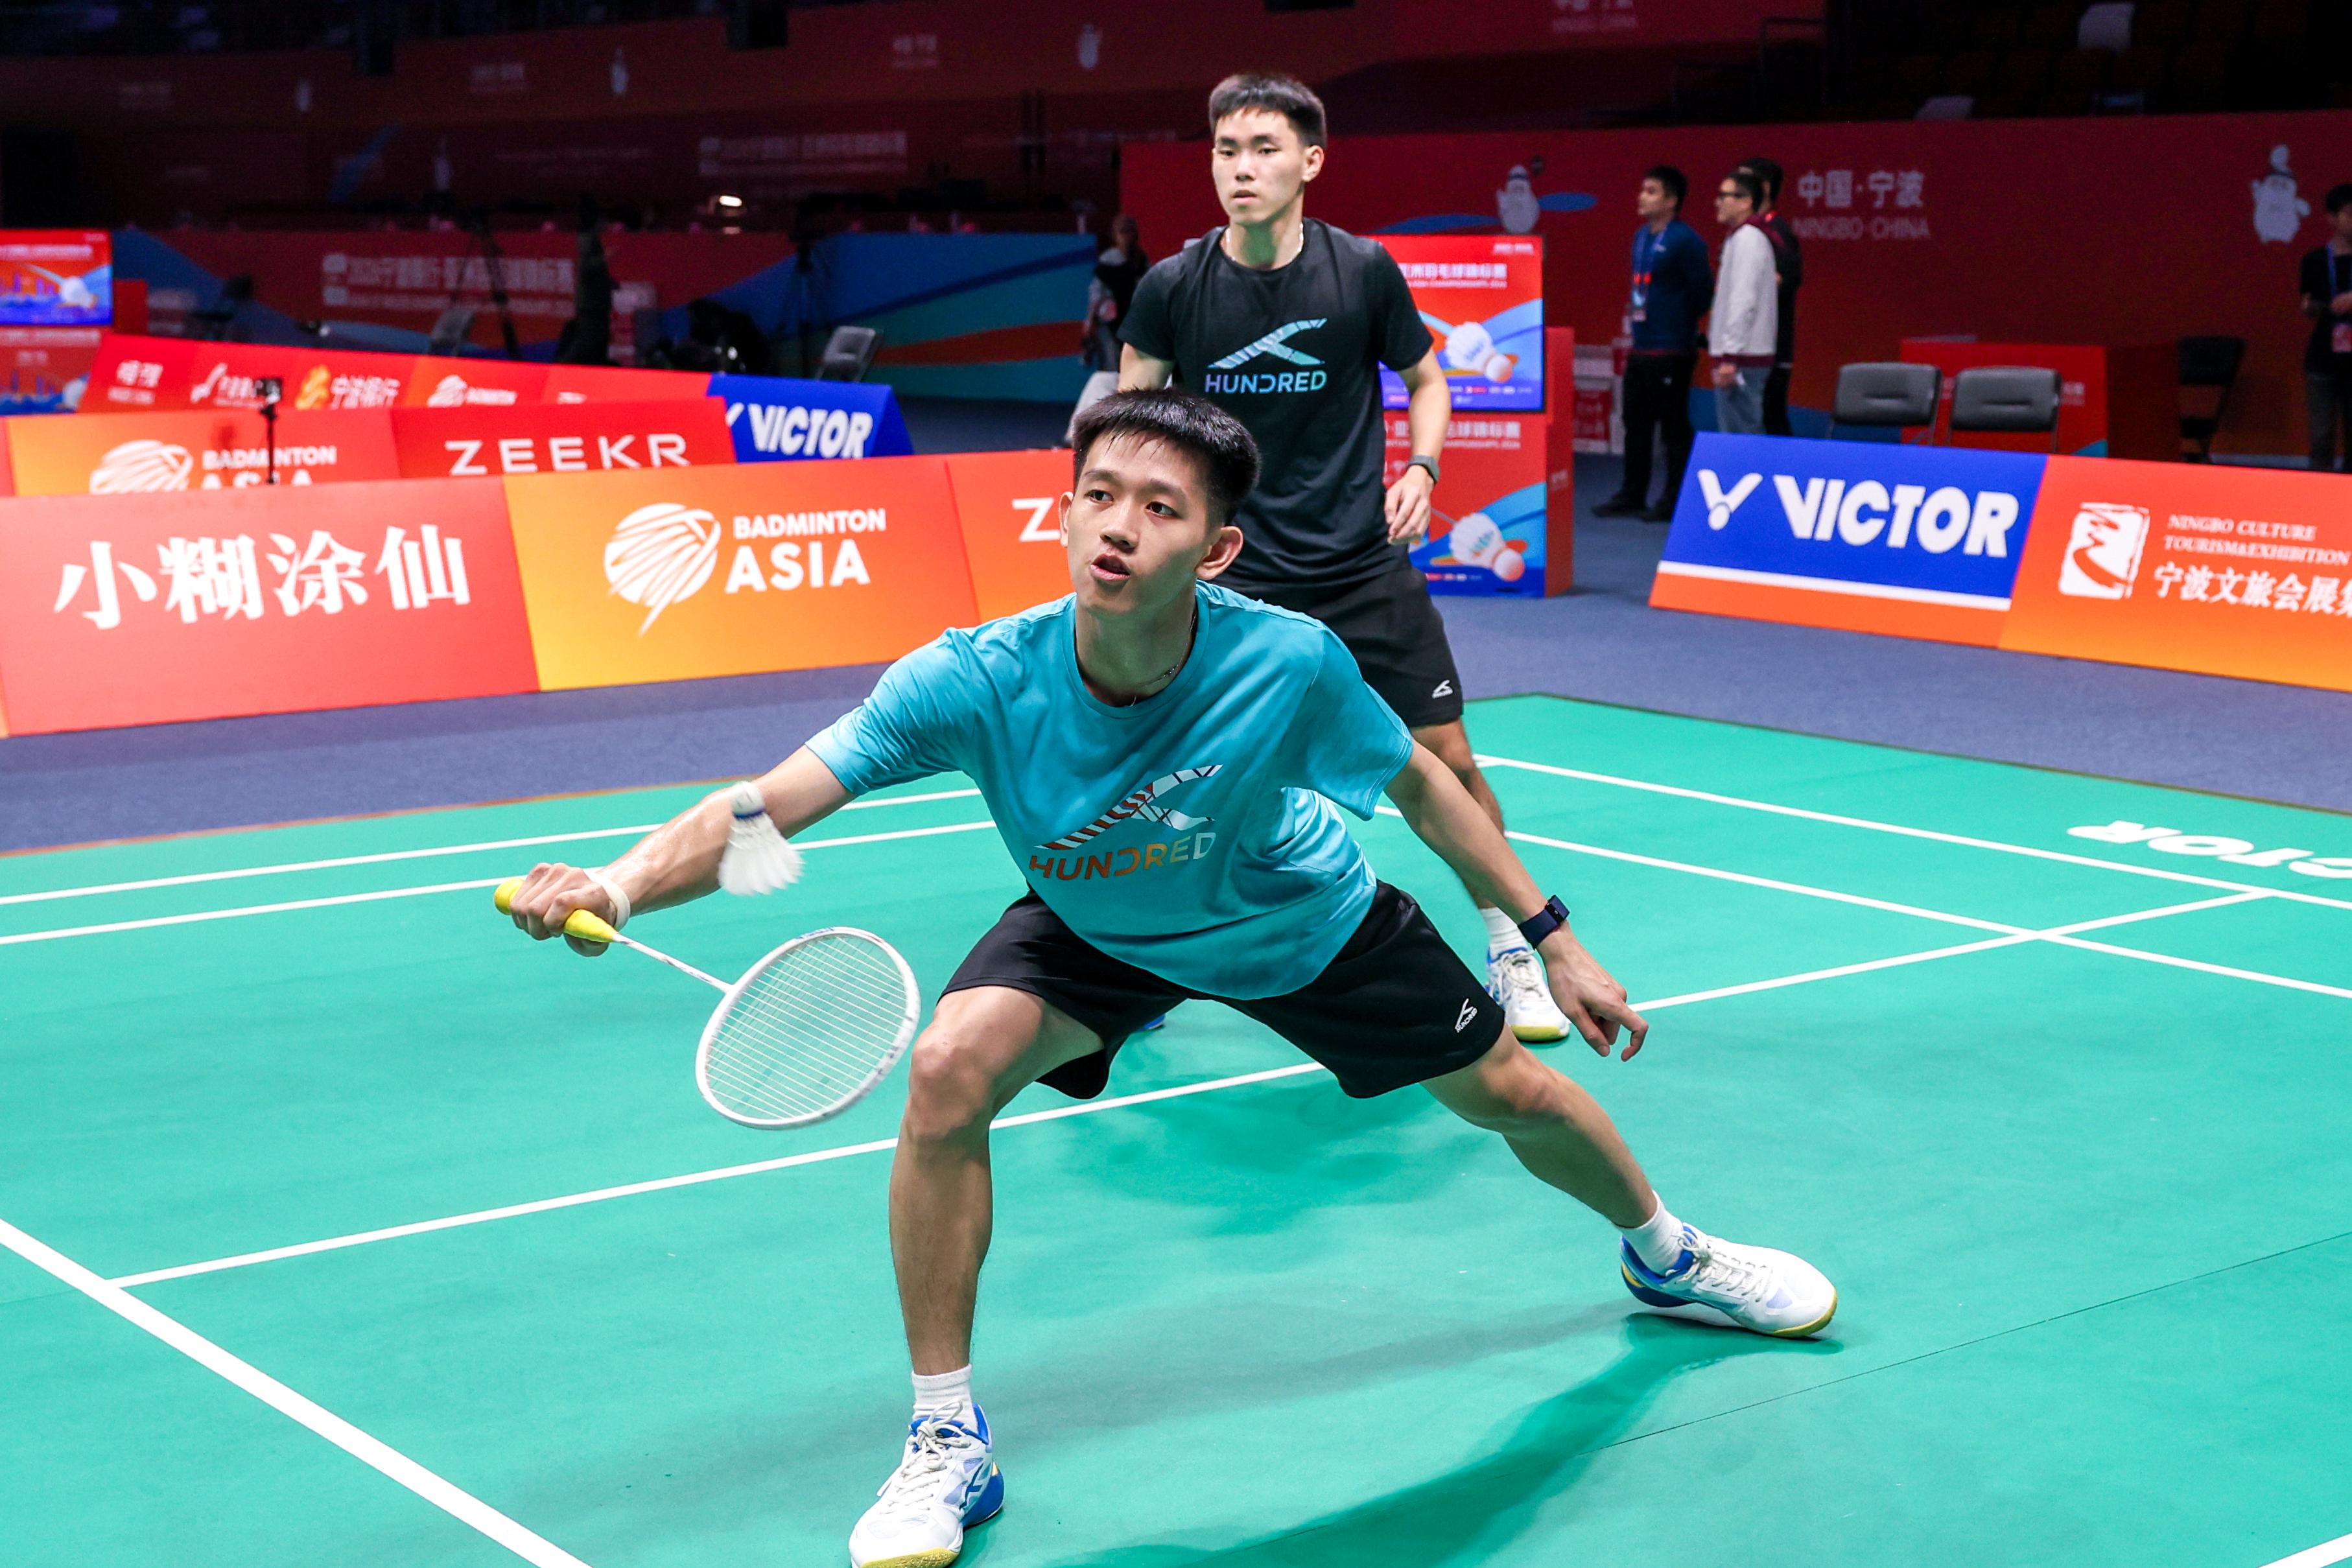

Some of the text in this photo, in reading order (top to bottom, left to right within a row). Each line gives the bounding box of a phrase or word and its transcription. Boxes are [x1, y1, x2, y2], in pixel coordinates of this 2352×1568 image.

[1797, 169, 1925, 209] 中国·宁波
[1871, 216, 1931, 239] CHINA
[1204, 369, 1328, 394] HUNDRED
[747, 403, 874, 460] VICTOR
[202, 445, 338, 471] BADMNTON
[445, 432, 691, 476] ZEEKR
[733, 508, 887, 539] BADMINTON
[1772, 474, 2019, 558] VICTOR
[2167, 514, 2318, 542] NINGBO CULTURE
[54, 522, 471, 629] 小糊涂仙
[723, 539, 871, 594] ASIA
[1029, 832, 1217, 880] HUNDRED
